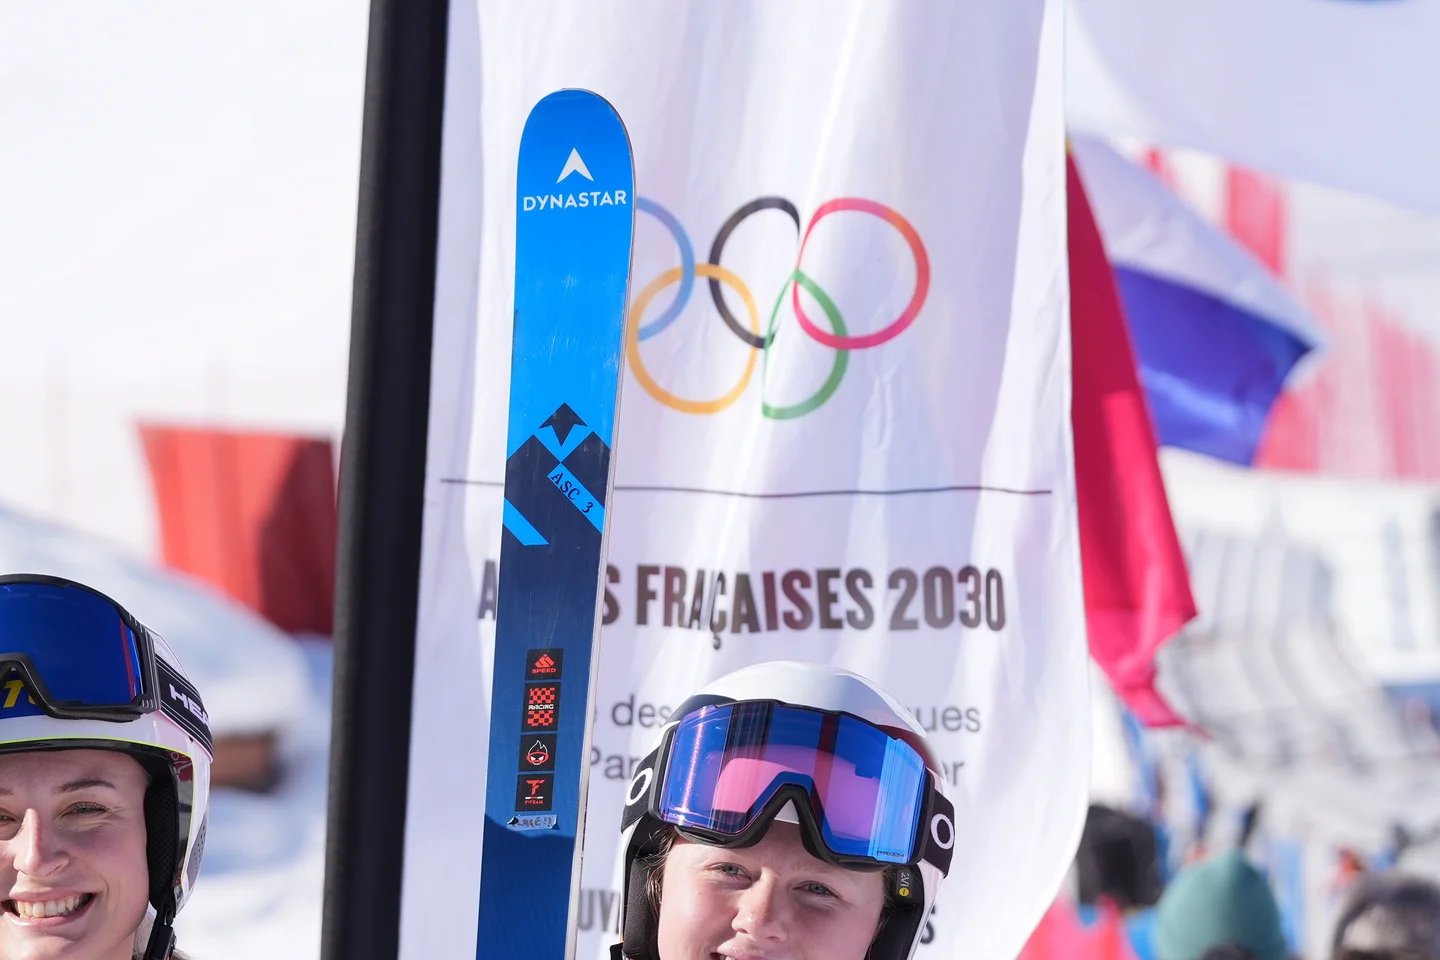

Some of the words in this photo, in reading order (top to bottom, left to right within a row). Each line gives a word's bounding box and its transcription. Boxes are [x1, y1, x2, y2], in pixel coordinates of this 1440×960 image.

[523, 190, 627, 211] DYNASTAR
[551, 472, 580, 501] ASC
[581, 501, 594, 513] 3
[887, 565, 1006, 631] 2030
